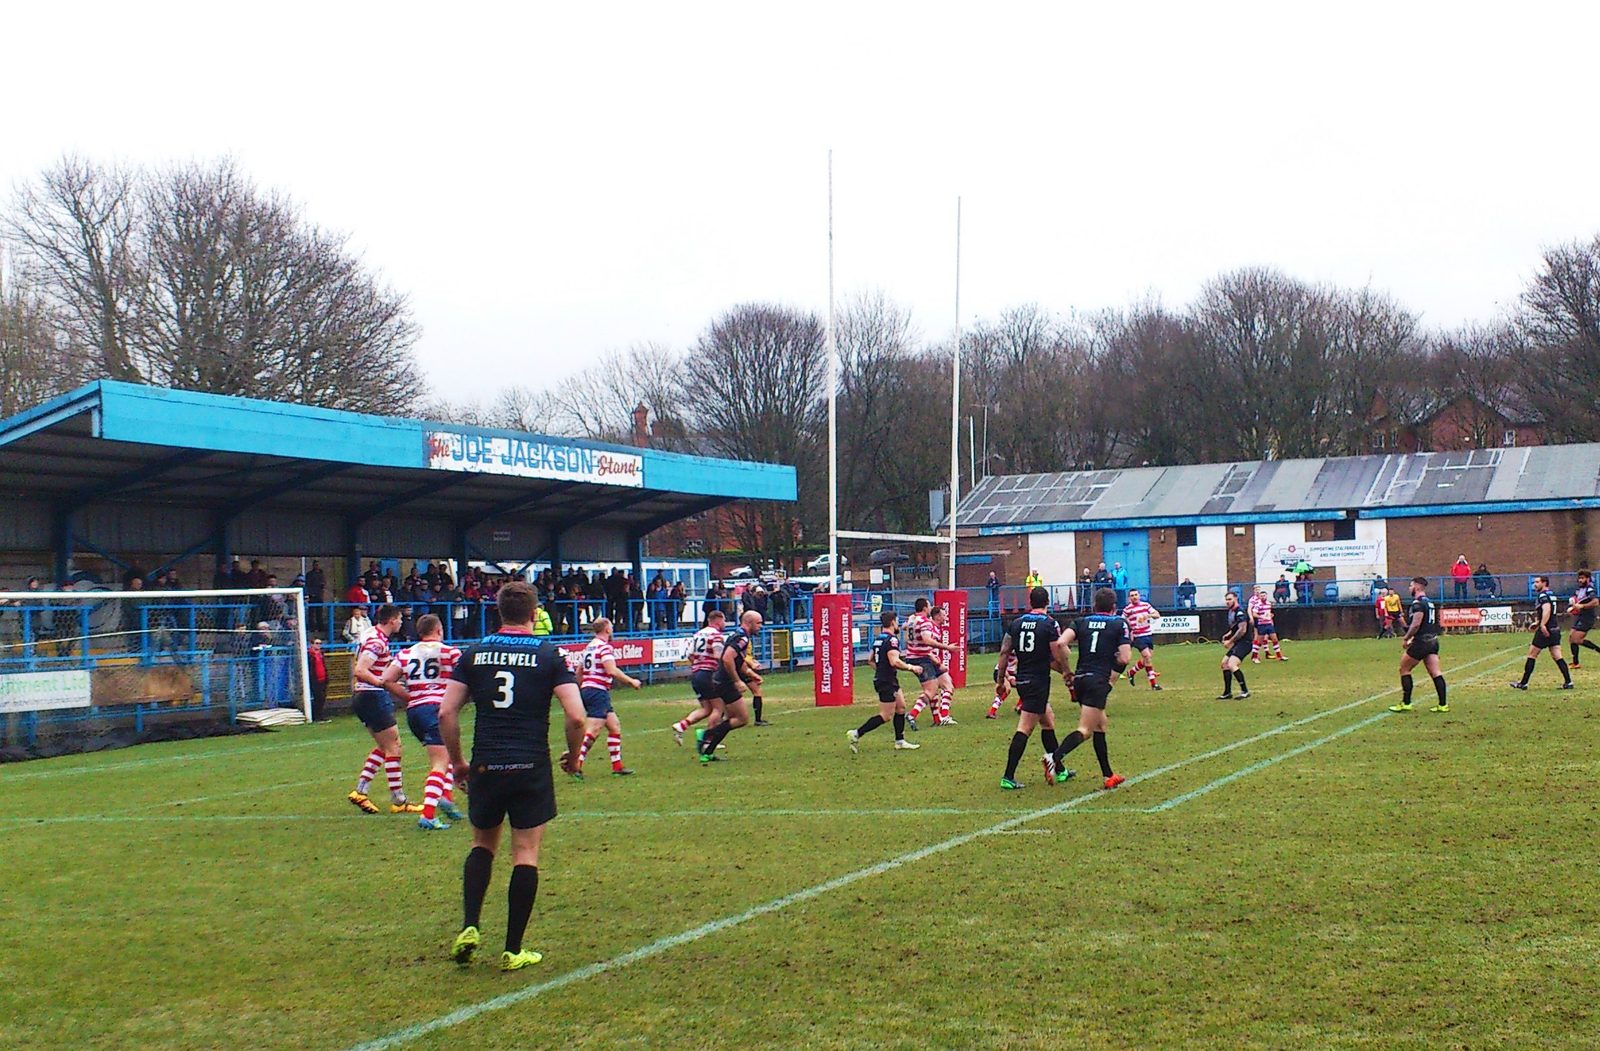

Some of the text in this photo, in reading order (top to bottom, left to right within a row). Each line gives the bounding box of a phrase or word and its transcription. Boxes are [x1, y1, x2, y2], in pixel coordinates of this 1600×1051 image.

[452, 434, 492, 463] JOE
[501, 438, 593, 474] JACKSON
[597, 455, 637, 477] Stand
[1088, 621, 1107, 629] KEAR
[623, 644, 643, 659] Cider
[693, 637, 706, 653] 12
[820, 607, 832, 694] Kingstone Press
[1019, 631, 1035, 653] 13
[1090, 631, 1099, 653] 1
[409, 658, 440, 680] 26
[473, 651, 539, 667] HELLEWELL
[584, 653, 592, 669] 6
[842, 646, 850, 687] PROPER
[492, 670, 515, 709] 3
